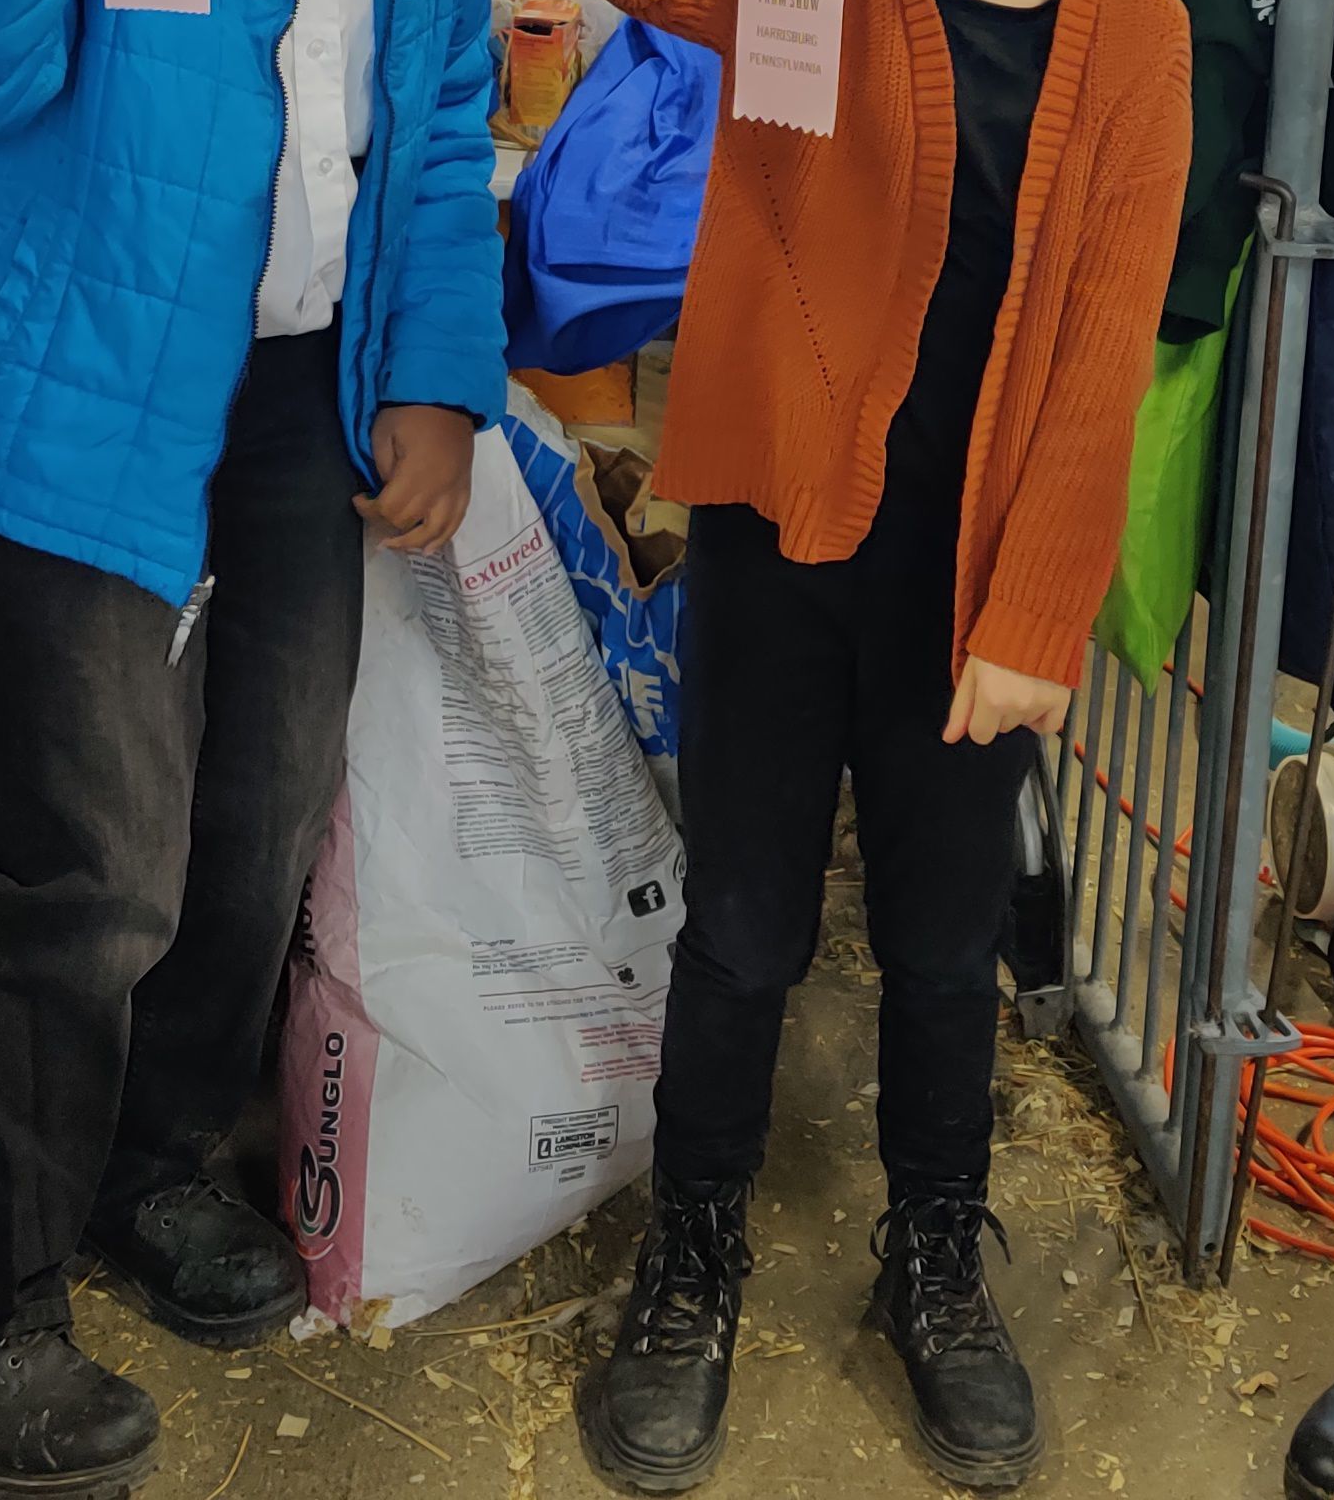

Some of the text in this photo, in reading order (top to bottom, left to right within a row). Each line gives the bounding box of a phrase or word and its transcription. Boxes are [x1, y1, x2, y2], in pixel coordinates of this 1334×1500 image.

[756, 25, 818, 47] HARRISBURG
[749, 52, 822, 76] PENNSYLVANIA
[299, 1030, 347, 1238] SUNGLO
